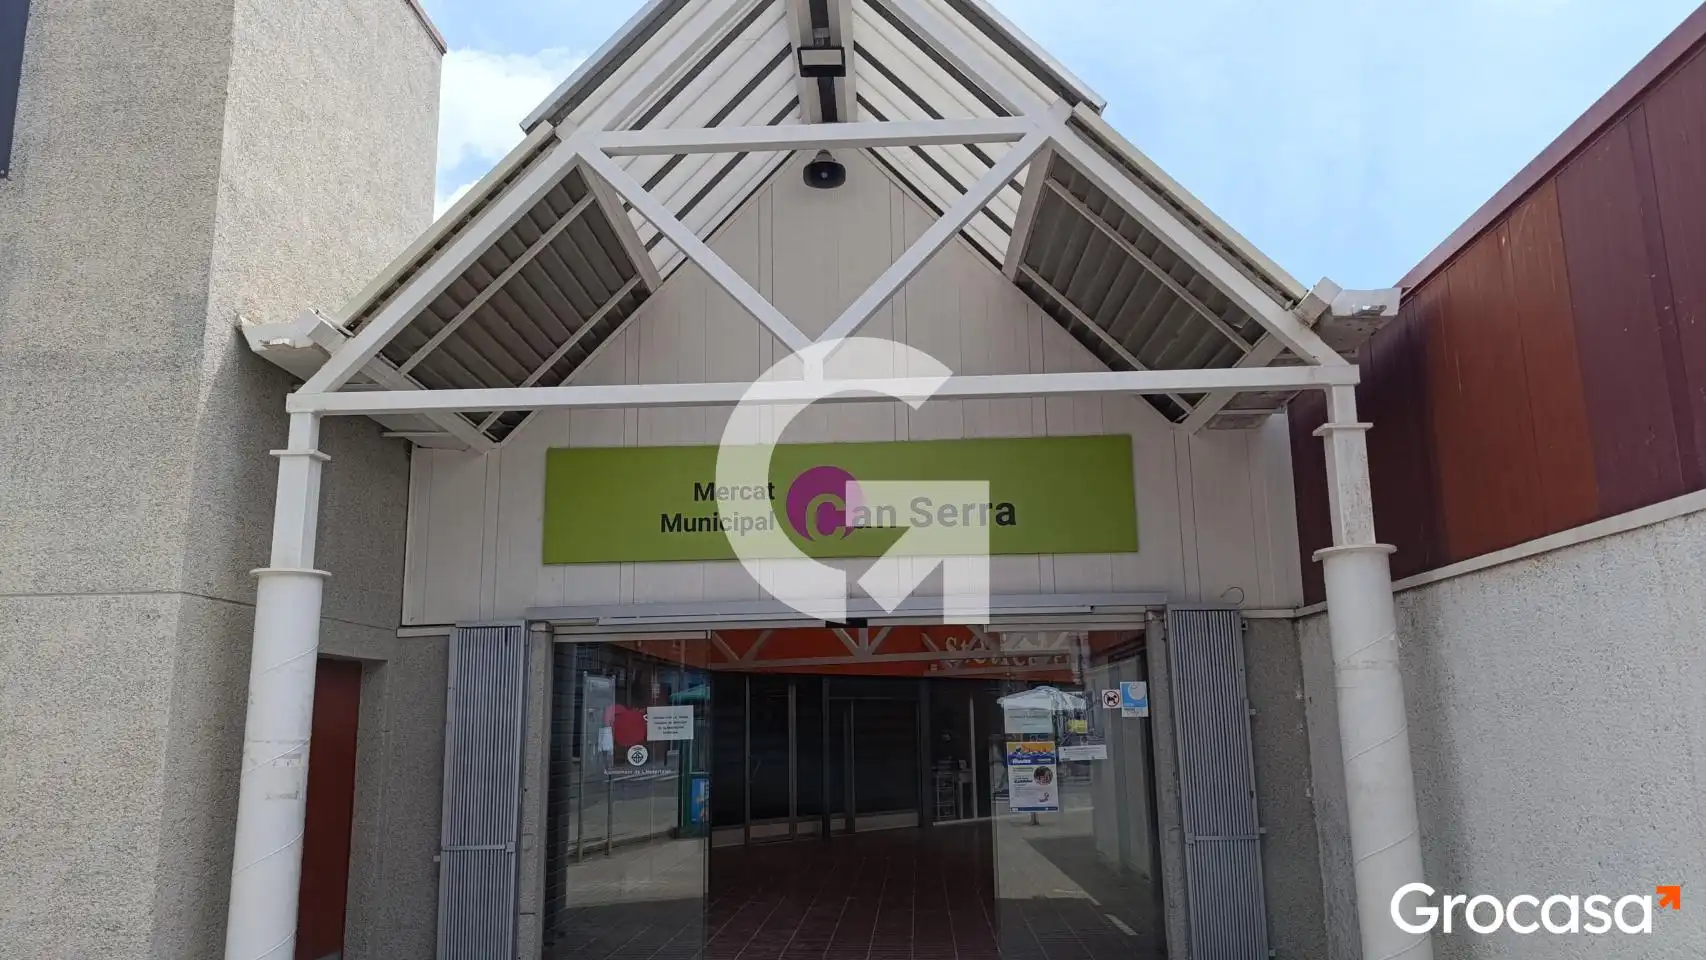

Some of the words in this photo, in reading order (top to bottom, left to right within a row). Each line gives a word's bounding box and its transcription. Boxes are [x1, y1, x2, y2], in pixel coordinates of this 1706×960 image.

[693, 481, 775, 502] Mercat
[660, 511, 775, 536] Municipal
[805, 493, 897, 541] Can
[909, 496, 1017, 529] Serra
